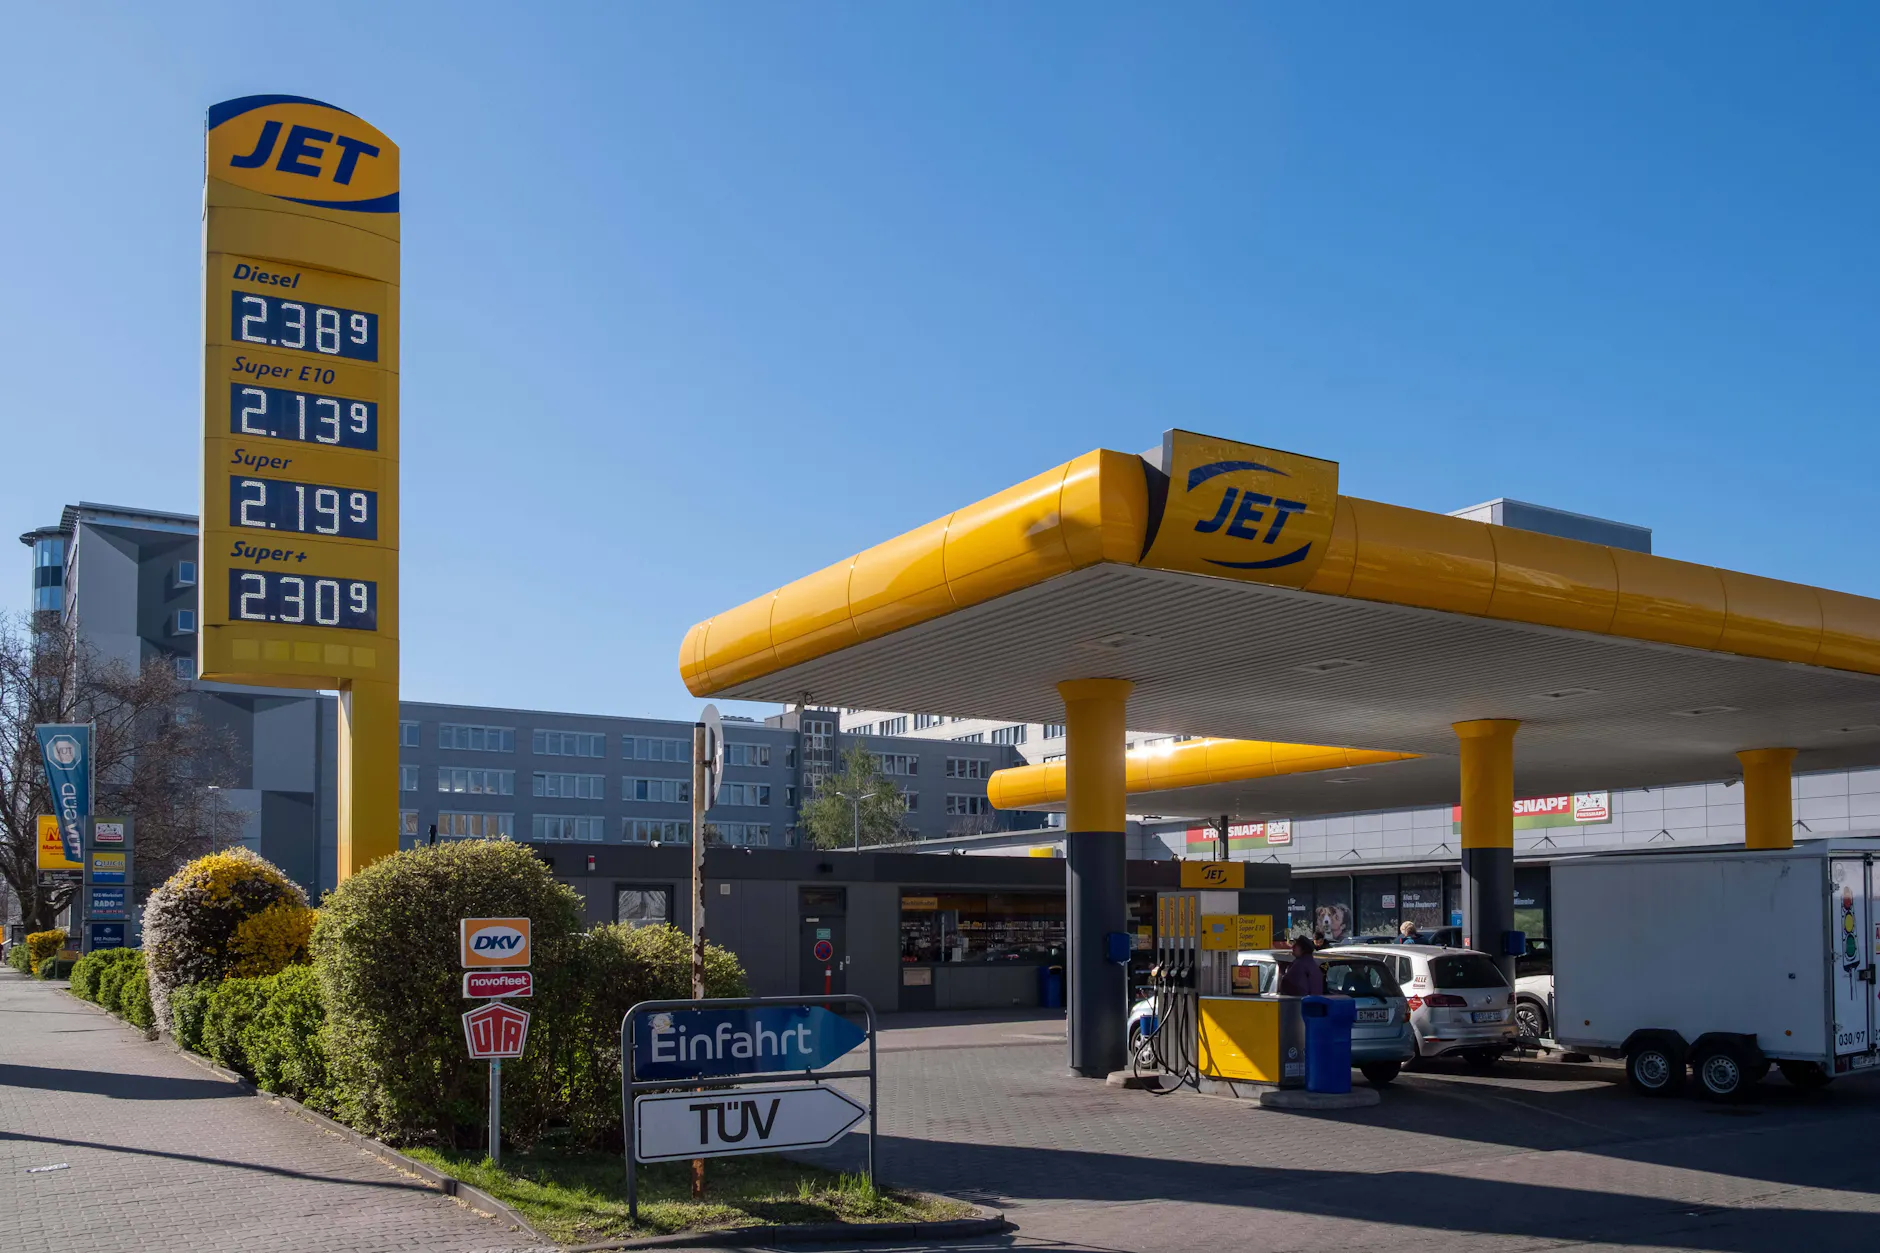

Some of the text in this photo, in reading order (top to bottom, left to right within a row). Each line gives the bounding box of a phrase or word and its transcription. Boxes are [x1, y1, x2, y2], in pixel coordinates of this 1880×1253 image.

[230, 120, 380, 185] JET
[233, 264, 300, 288] Diesel
[242, 296, 368, 354] 2.389
[232, 356, 335, 385] Super E10
[241, 388, 368, 444] 2.139
[231, 449, 292, 471] Super
[240, 480, 368, 535] 2.199
[1194, 487, 1307, 544] JET
[230, 541, 307, 564] Super+
[240, 573, 368, 625] 2.309
[1513, 796, 1567, 814] SNAPF
[1204, 869, 1225, 880] JET
[474, 935, 522, 950] DKV
[471, 976, 527, 987] novofleet
[470, 1006, 525, 1053] UTA
[651, 1021, 813, 1063] Einfahrt
[1838, 1031, 1866, 1046] 030/97
[689, 1099, 781, 1145] TÜV
